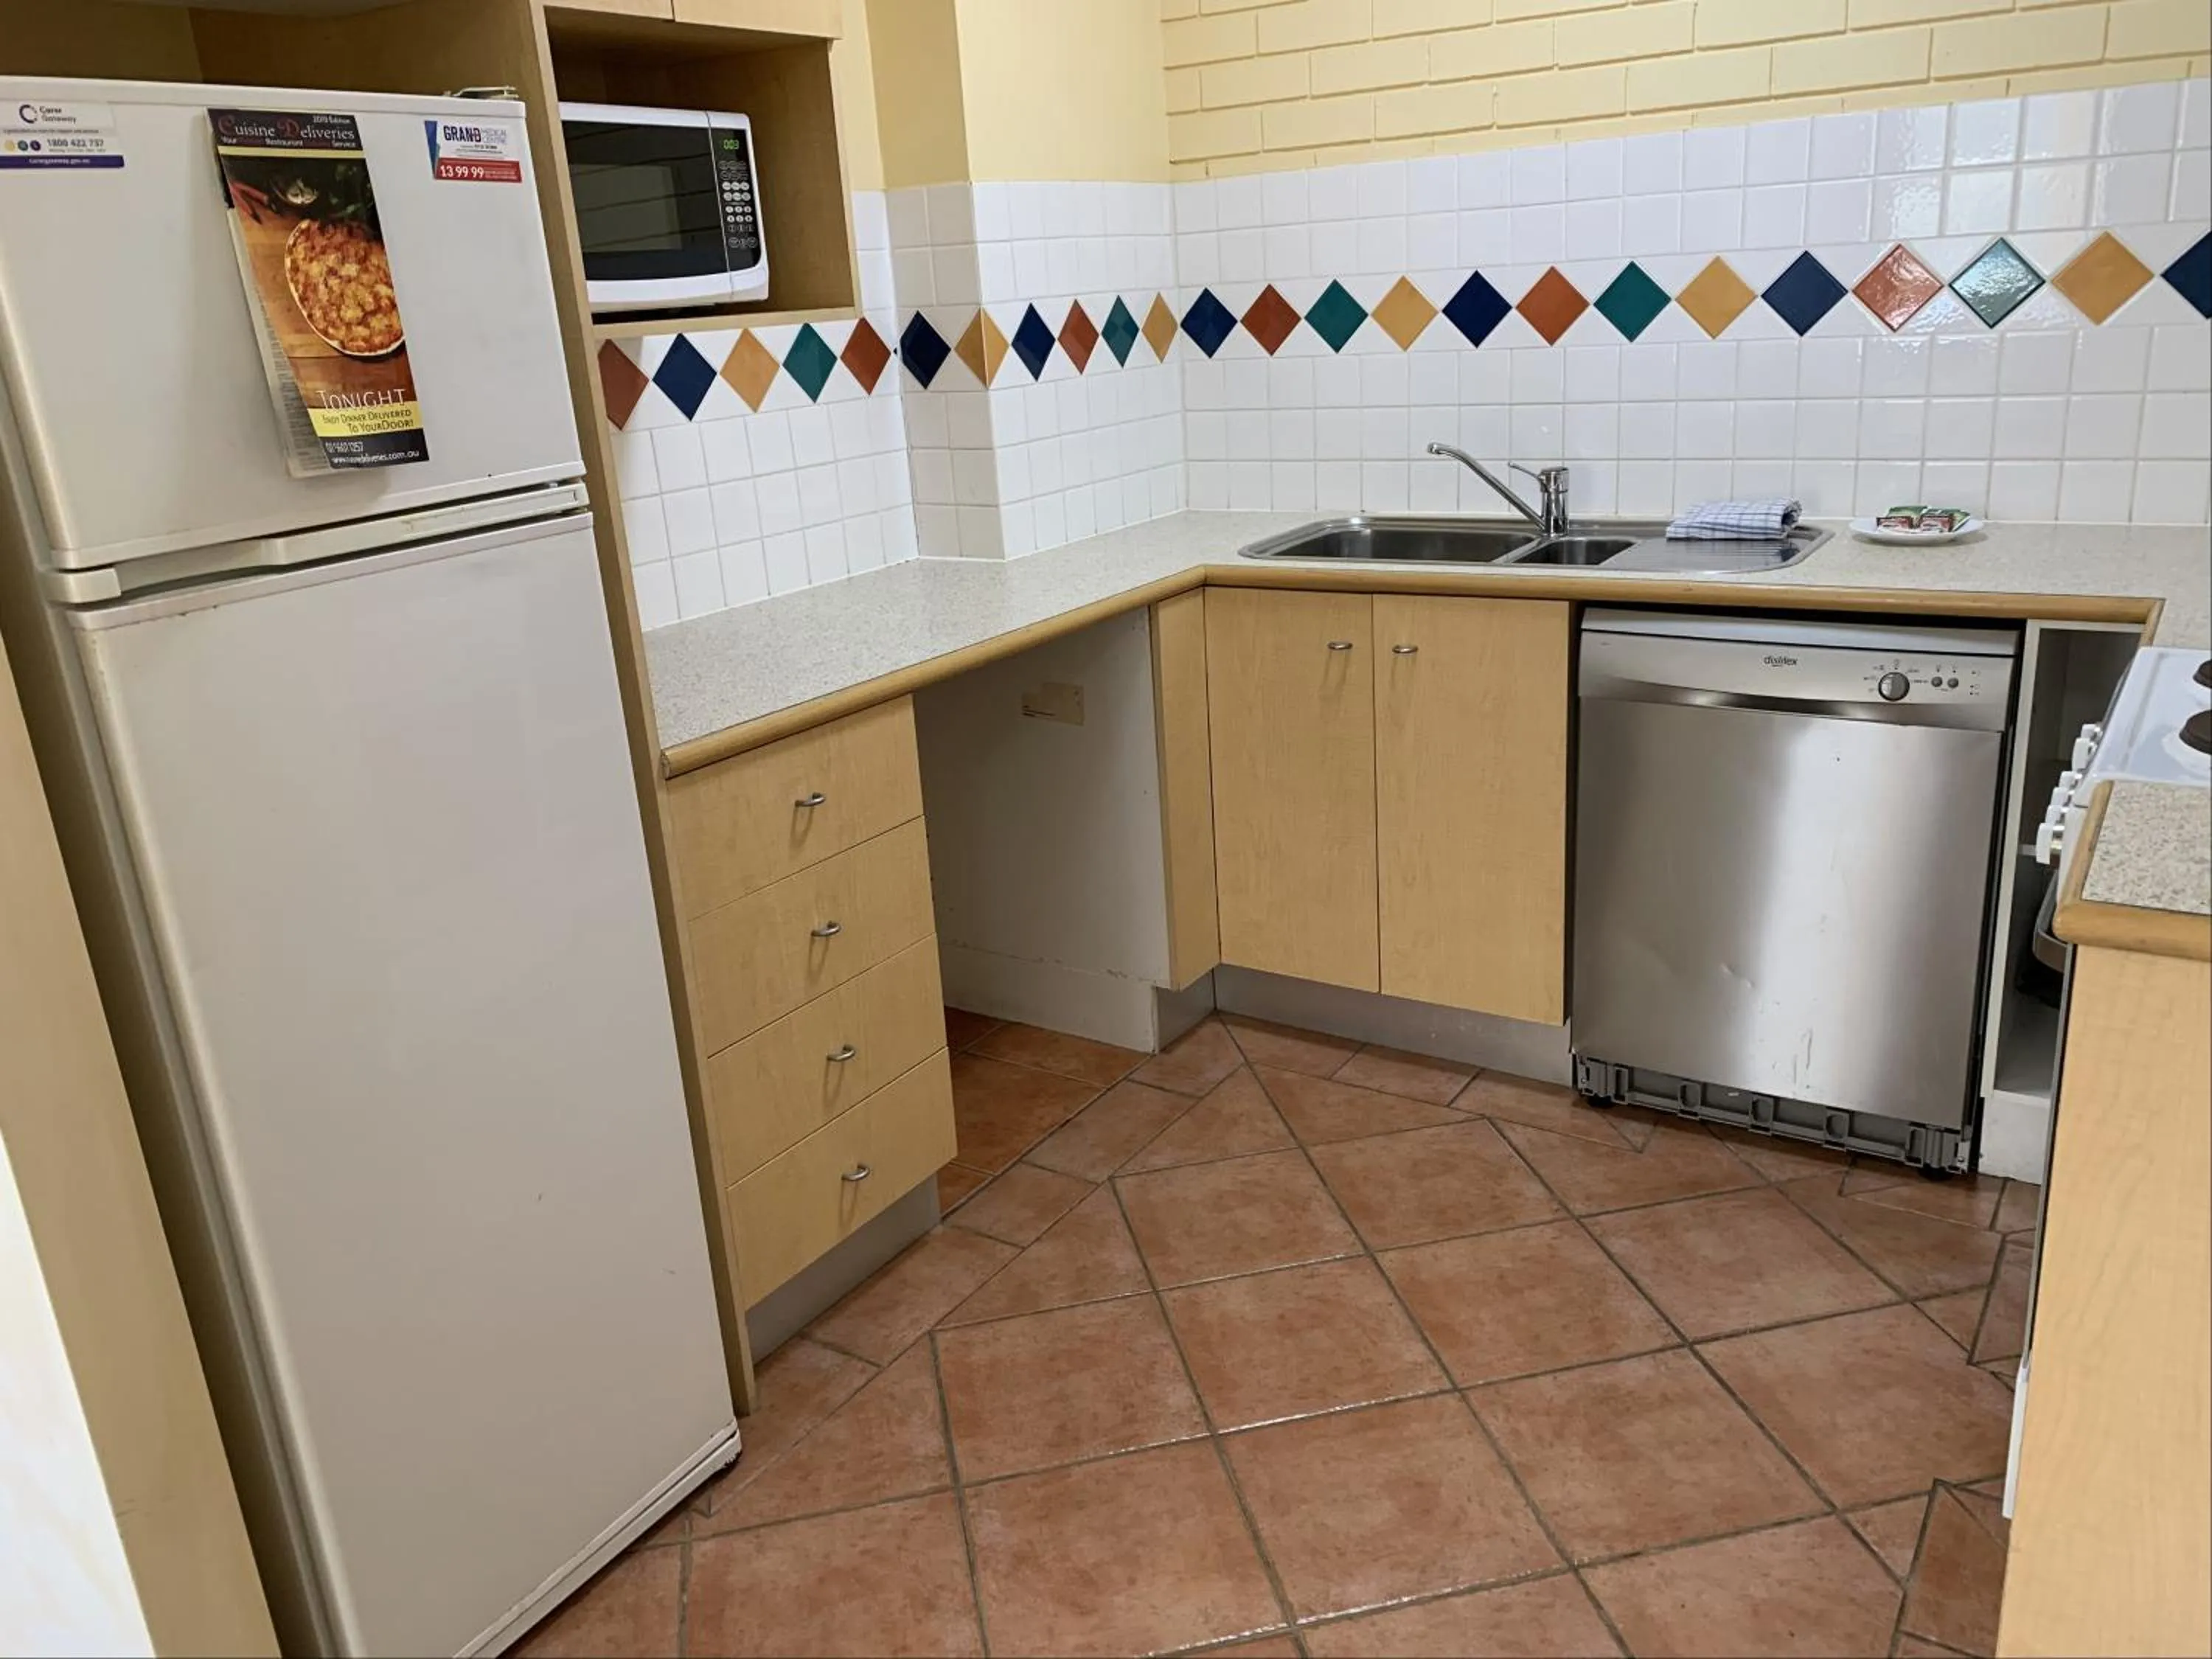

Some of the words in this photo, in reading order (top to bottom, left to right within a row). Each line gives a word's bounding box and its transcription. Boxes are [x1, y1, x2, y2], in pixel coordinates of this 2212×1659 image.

[218, 114, 276, 137] Cuisine
[276, 117, 355, 140] Deliveries
[440, 165, 453, 178] 13
[455, 166, 468, 178] 99
[471, 167, 484, 178] 99
[316, 389, 406, 413] TONIGHT
[368, 409, 411, 421] DELIVERED
